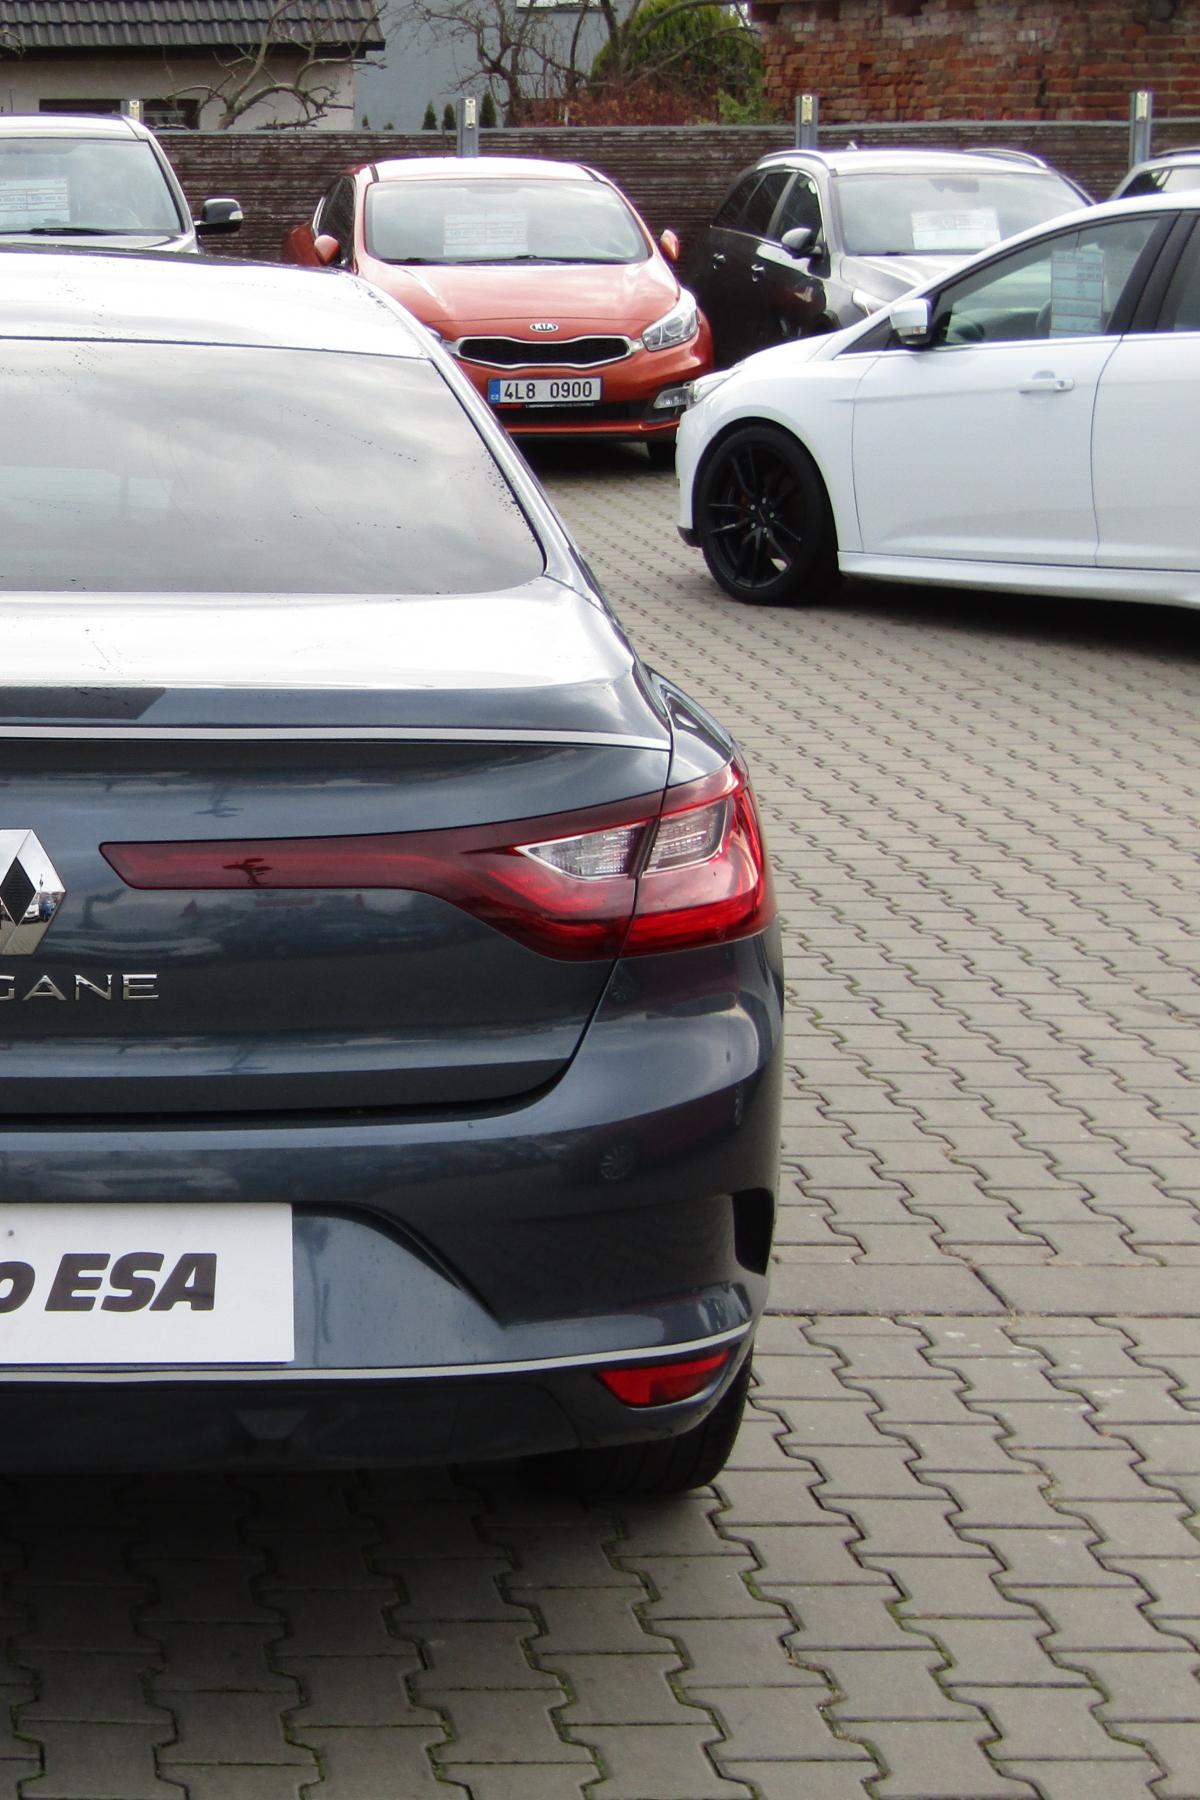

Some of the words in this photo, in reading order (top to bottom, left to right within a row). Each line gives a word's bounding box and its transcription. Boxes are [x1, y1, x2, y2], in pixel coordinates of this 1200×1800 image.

[532, 322, 556, 331] KIA
[504, 382, 536, 400] 4L8
[550, 381, 592, 399] 0900
[44, 1251, 218, 1313] ESA
